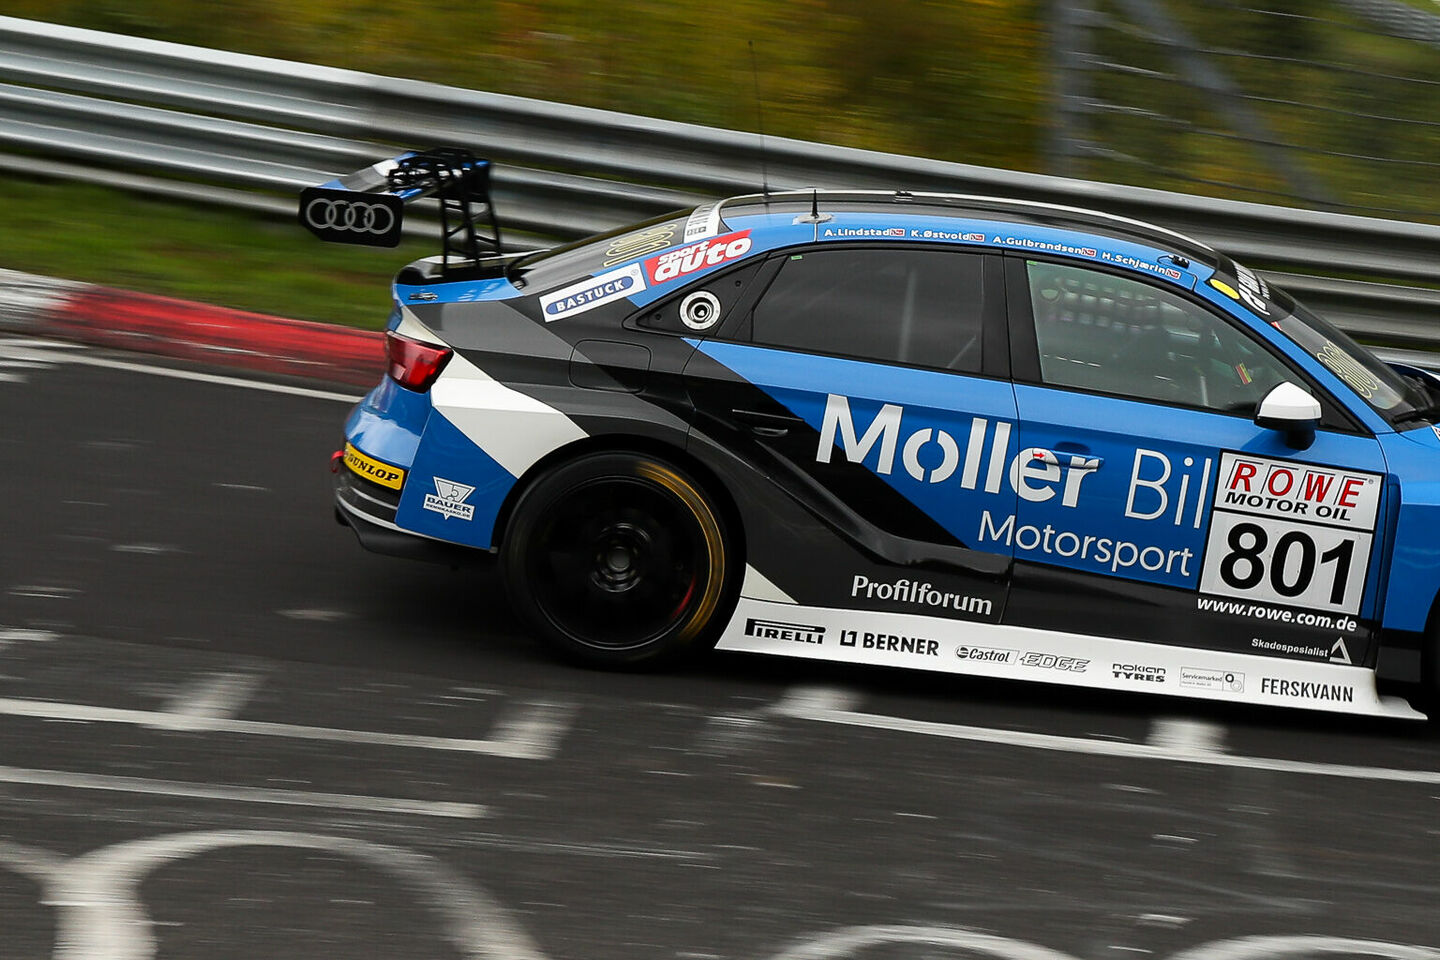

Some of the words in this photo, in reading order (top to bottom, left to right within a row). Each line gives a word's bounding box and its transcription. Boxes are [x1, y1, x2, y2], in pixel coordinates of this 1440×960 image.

[654, 238, 752, 283] auto
[657, 240, 709, 266] sport
[554, 279, 625, 312] BASTUCK
[1125, 448, 1212, 529] Bil
[1229, 462, 1365, 508] ROWE
[427, 497, 471, 514] BAUER
[1224, 491, 1309, 515] MOTOR
[1315, 505, 1351, 521] OIL
[978, 510, 1193, 577] Motorsport
[1220, 522, 1355, 605] 801
[851, 575, 993, 615] Profilforum
[1197, 598, 1357, 631] www.rowe.com.de
[744, 618, 827, 644] PIRELLI
[863, 632, 940, 656] BERNER
[969, 648, 1011, 663] Castrol
[1020, 652, 1091, 673] EDGE
[1112, 663, 1167, 675] nokian
[1112, 671, 1166, 683] TYRES
[1261, 677, 1354, 703] FERSKVANN
